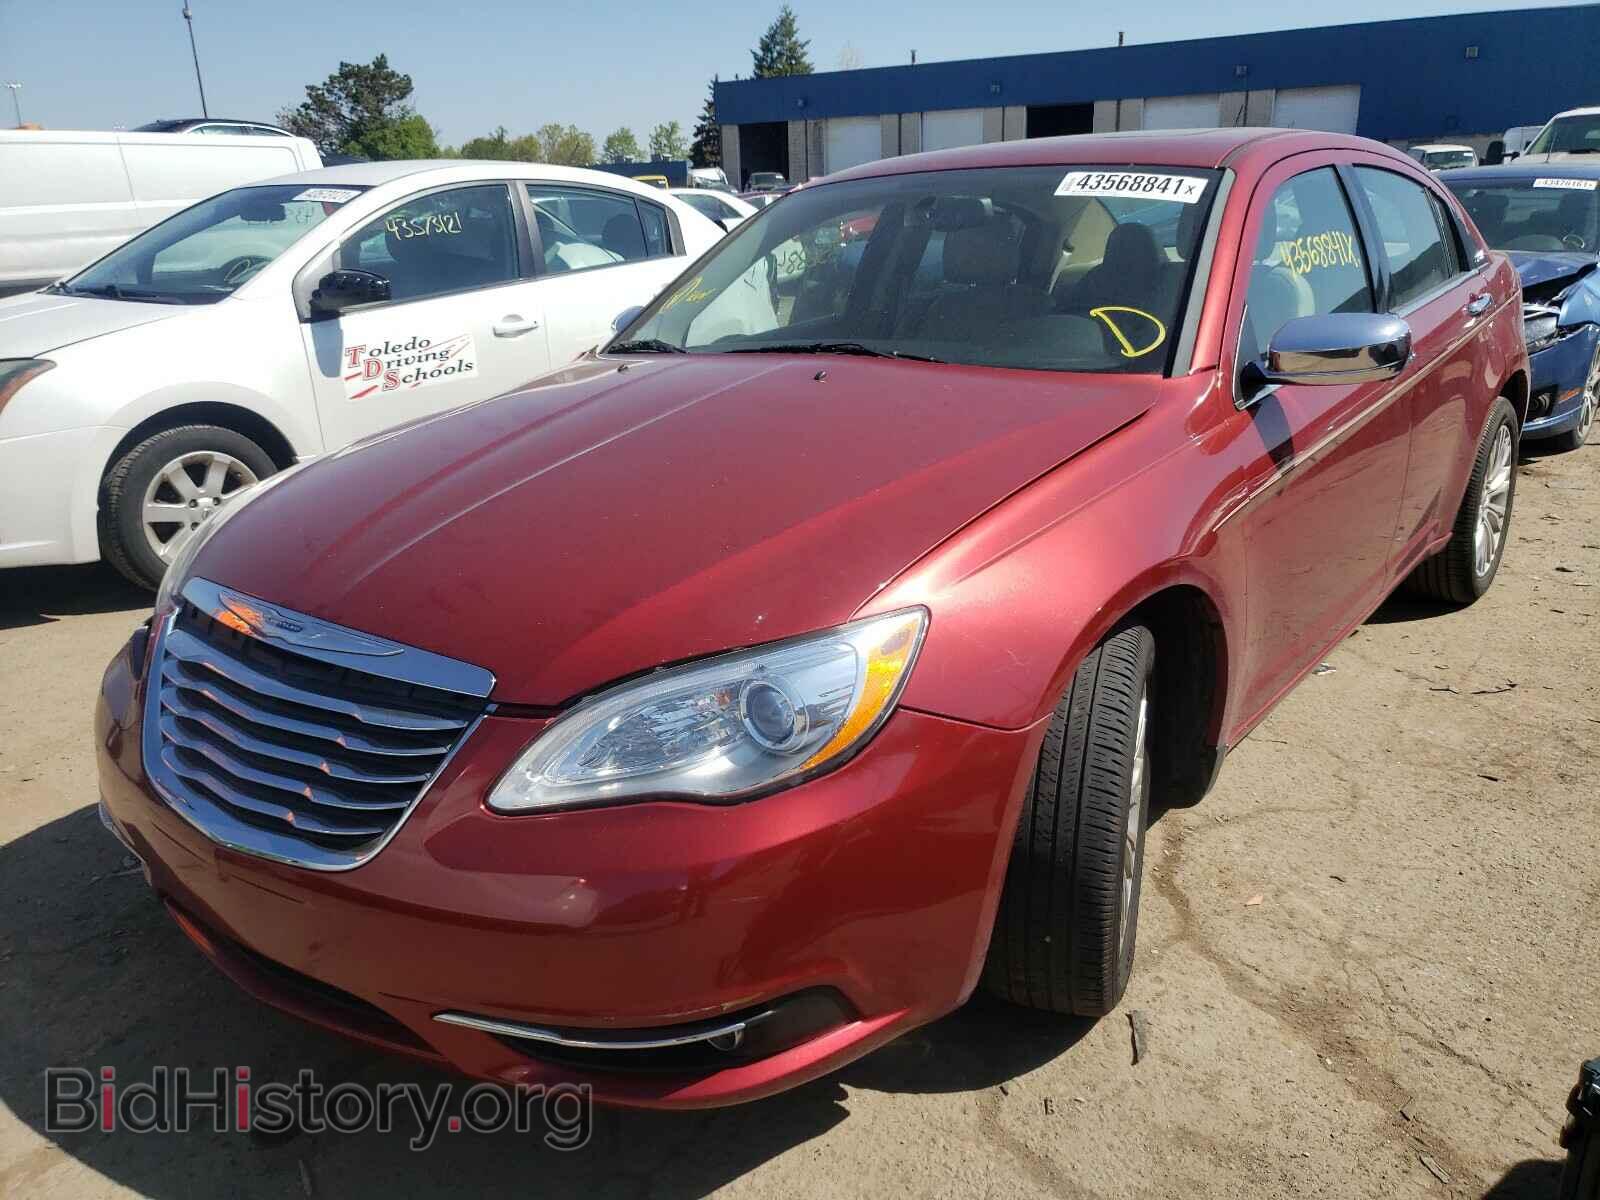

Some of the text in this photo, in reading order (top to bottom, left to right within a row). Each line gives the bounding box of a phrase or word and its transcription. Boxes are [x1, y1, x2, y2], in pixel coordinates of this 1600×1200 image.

[1089, 306, 1166, 358] D
[345, 337, 432, 368] Toledo
[363, 348, 450, 381] Driving
[383, 360, 475, 392] Schools
